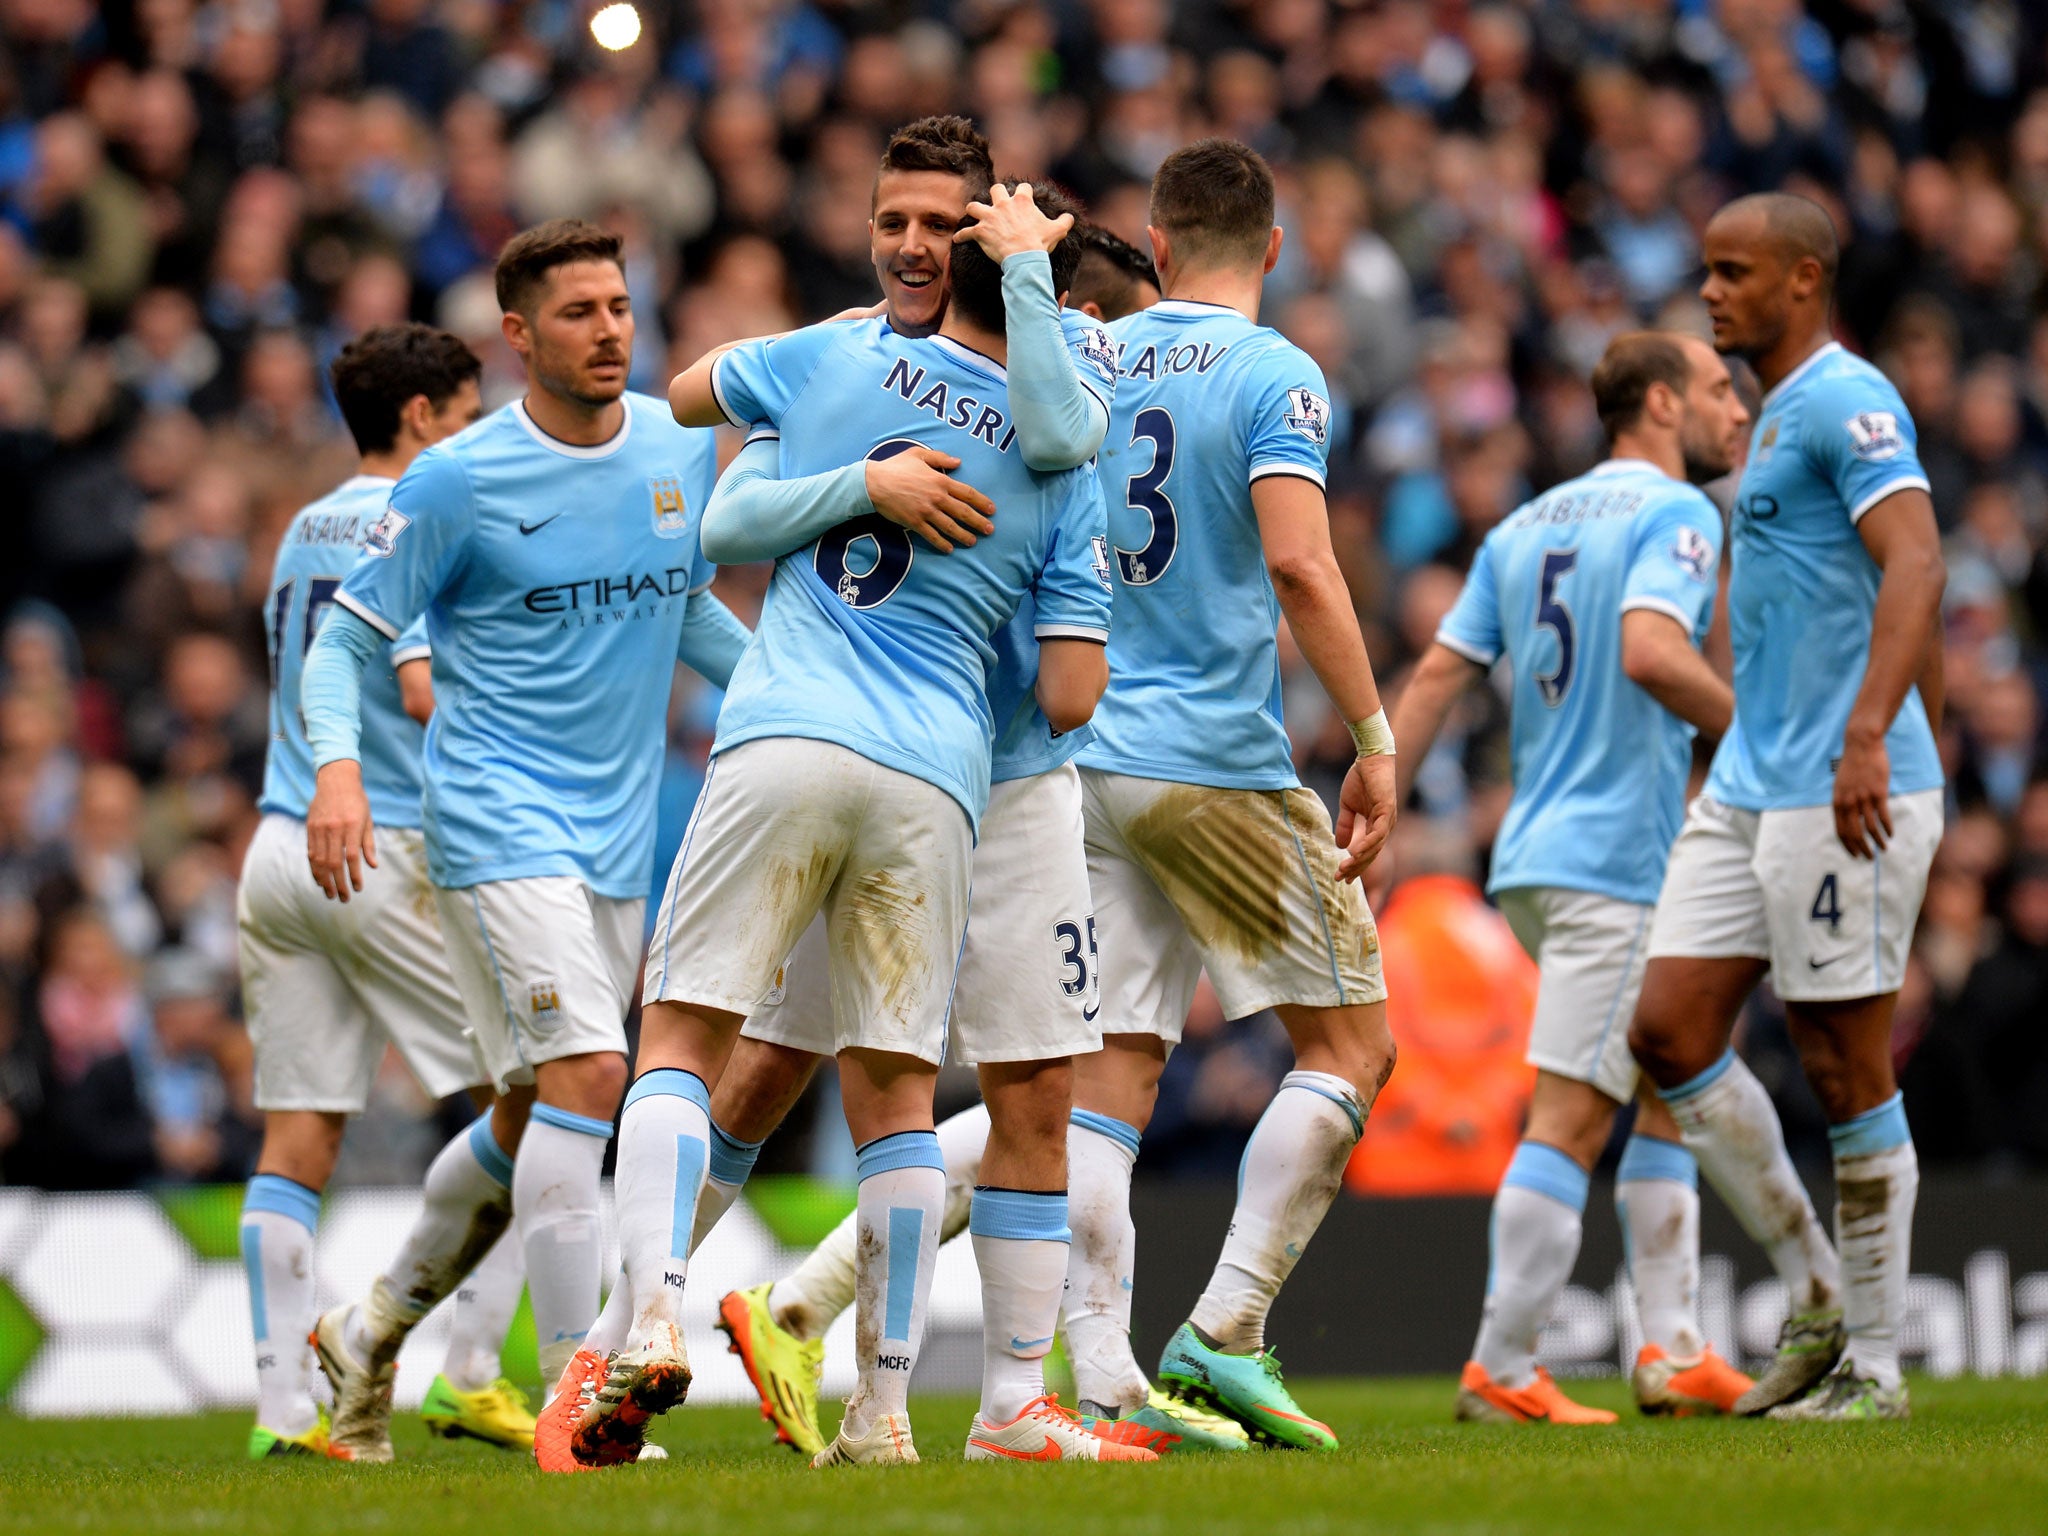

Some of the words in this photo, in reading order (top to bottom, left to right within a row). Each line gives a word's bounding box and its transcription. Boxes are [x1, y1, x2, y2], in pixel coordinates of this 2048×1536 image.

[881, 356, 1017, 453] NASRI
[1113, 406, 1178, 586] 3
[524, 567, 689, 613] ETIHAD
[559, 604, 671, 630] AIRWAYS
[1533, 548, 1579, 708] 5
[1809, 873, 1844, 928] 4
[878, 1354, 910, 1371] MCFC
[1092, 1419, 1183, 1454] NIKE
